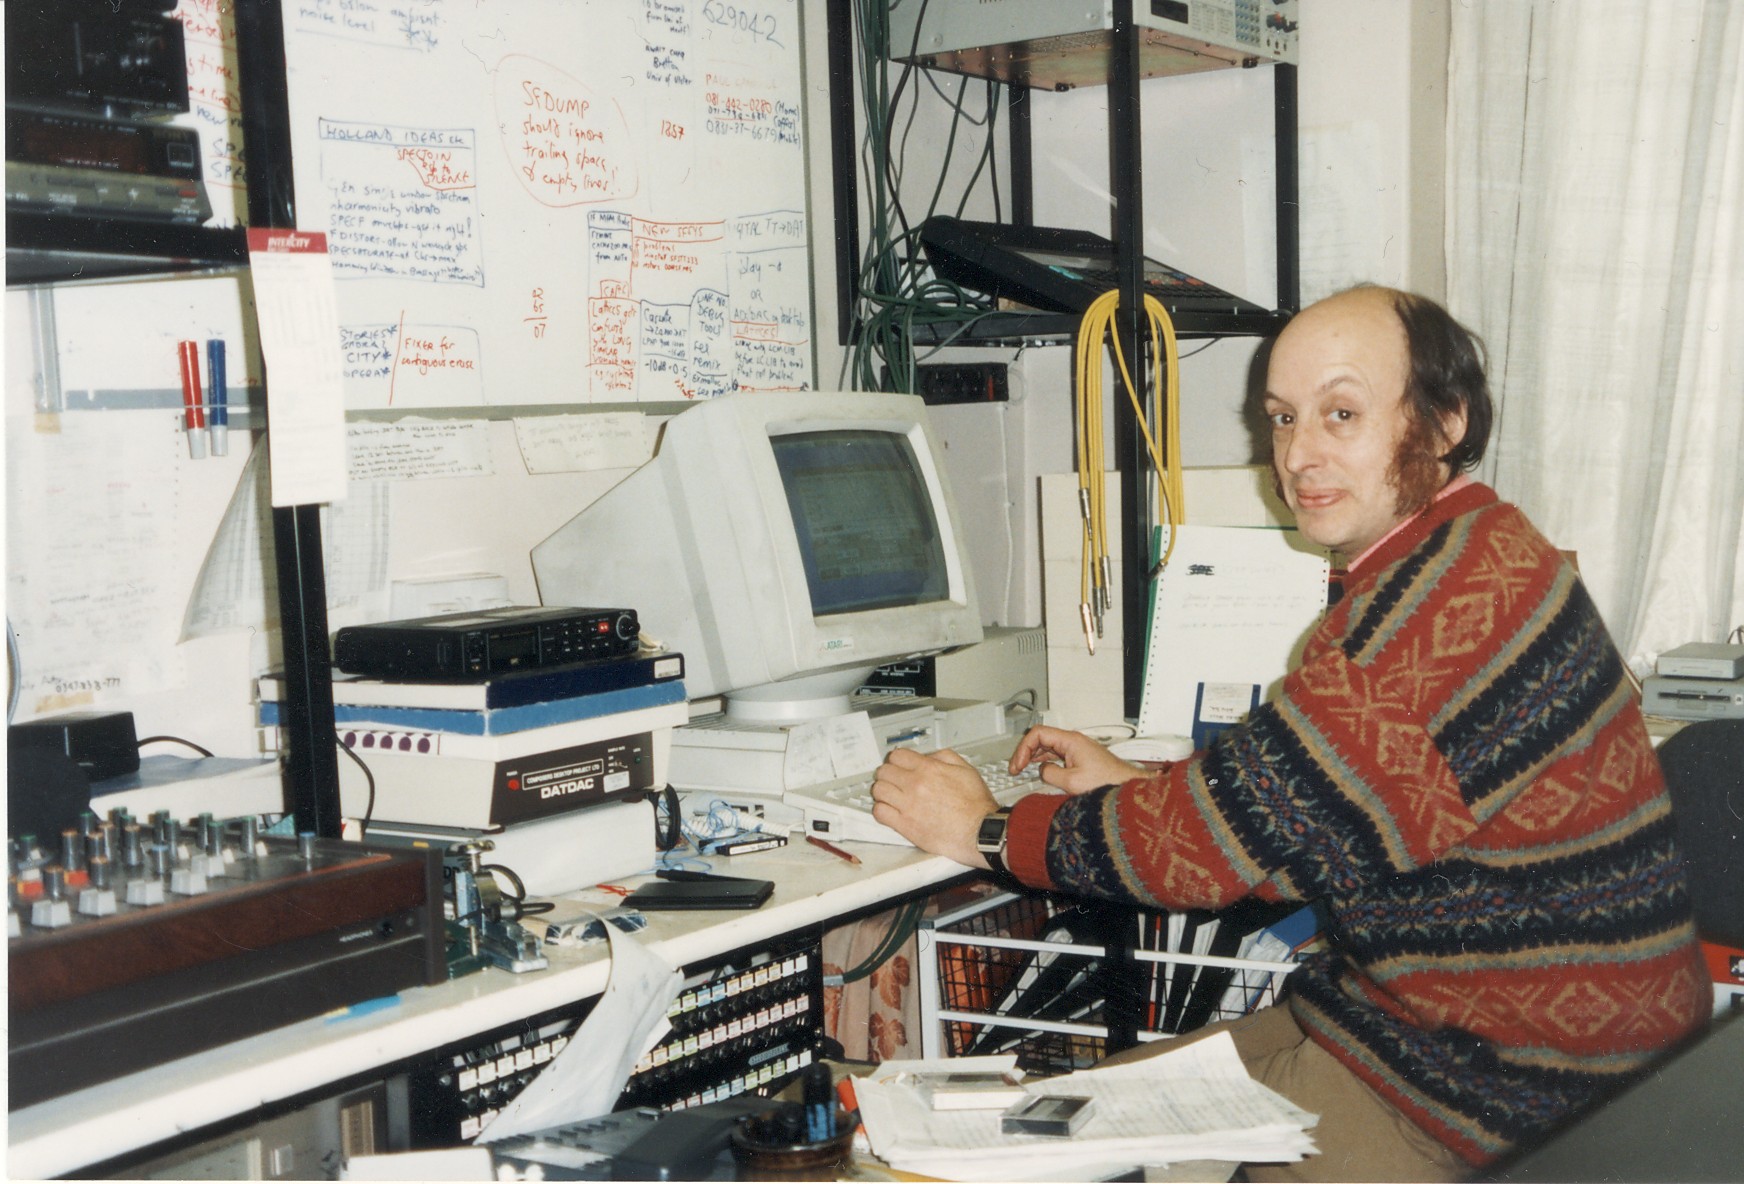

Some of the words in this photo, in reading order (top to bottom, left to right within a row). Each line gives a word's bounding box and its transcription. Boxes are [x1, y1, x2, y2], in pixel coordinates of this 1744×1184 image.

[702, 0, 786, 49] 629042
[522, 80, 590, 119] SFDUMP
[326, 125, 393, 141] HOLLAND
[405, 131, 443, 143] IDEAS
[523, 113, 560, 138] should
[522, 140, 569, 170] trailing
[827, 640, 843, 650] ATARI
[540, 778, 594, 799] DATDAC
